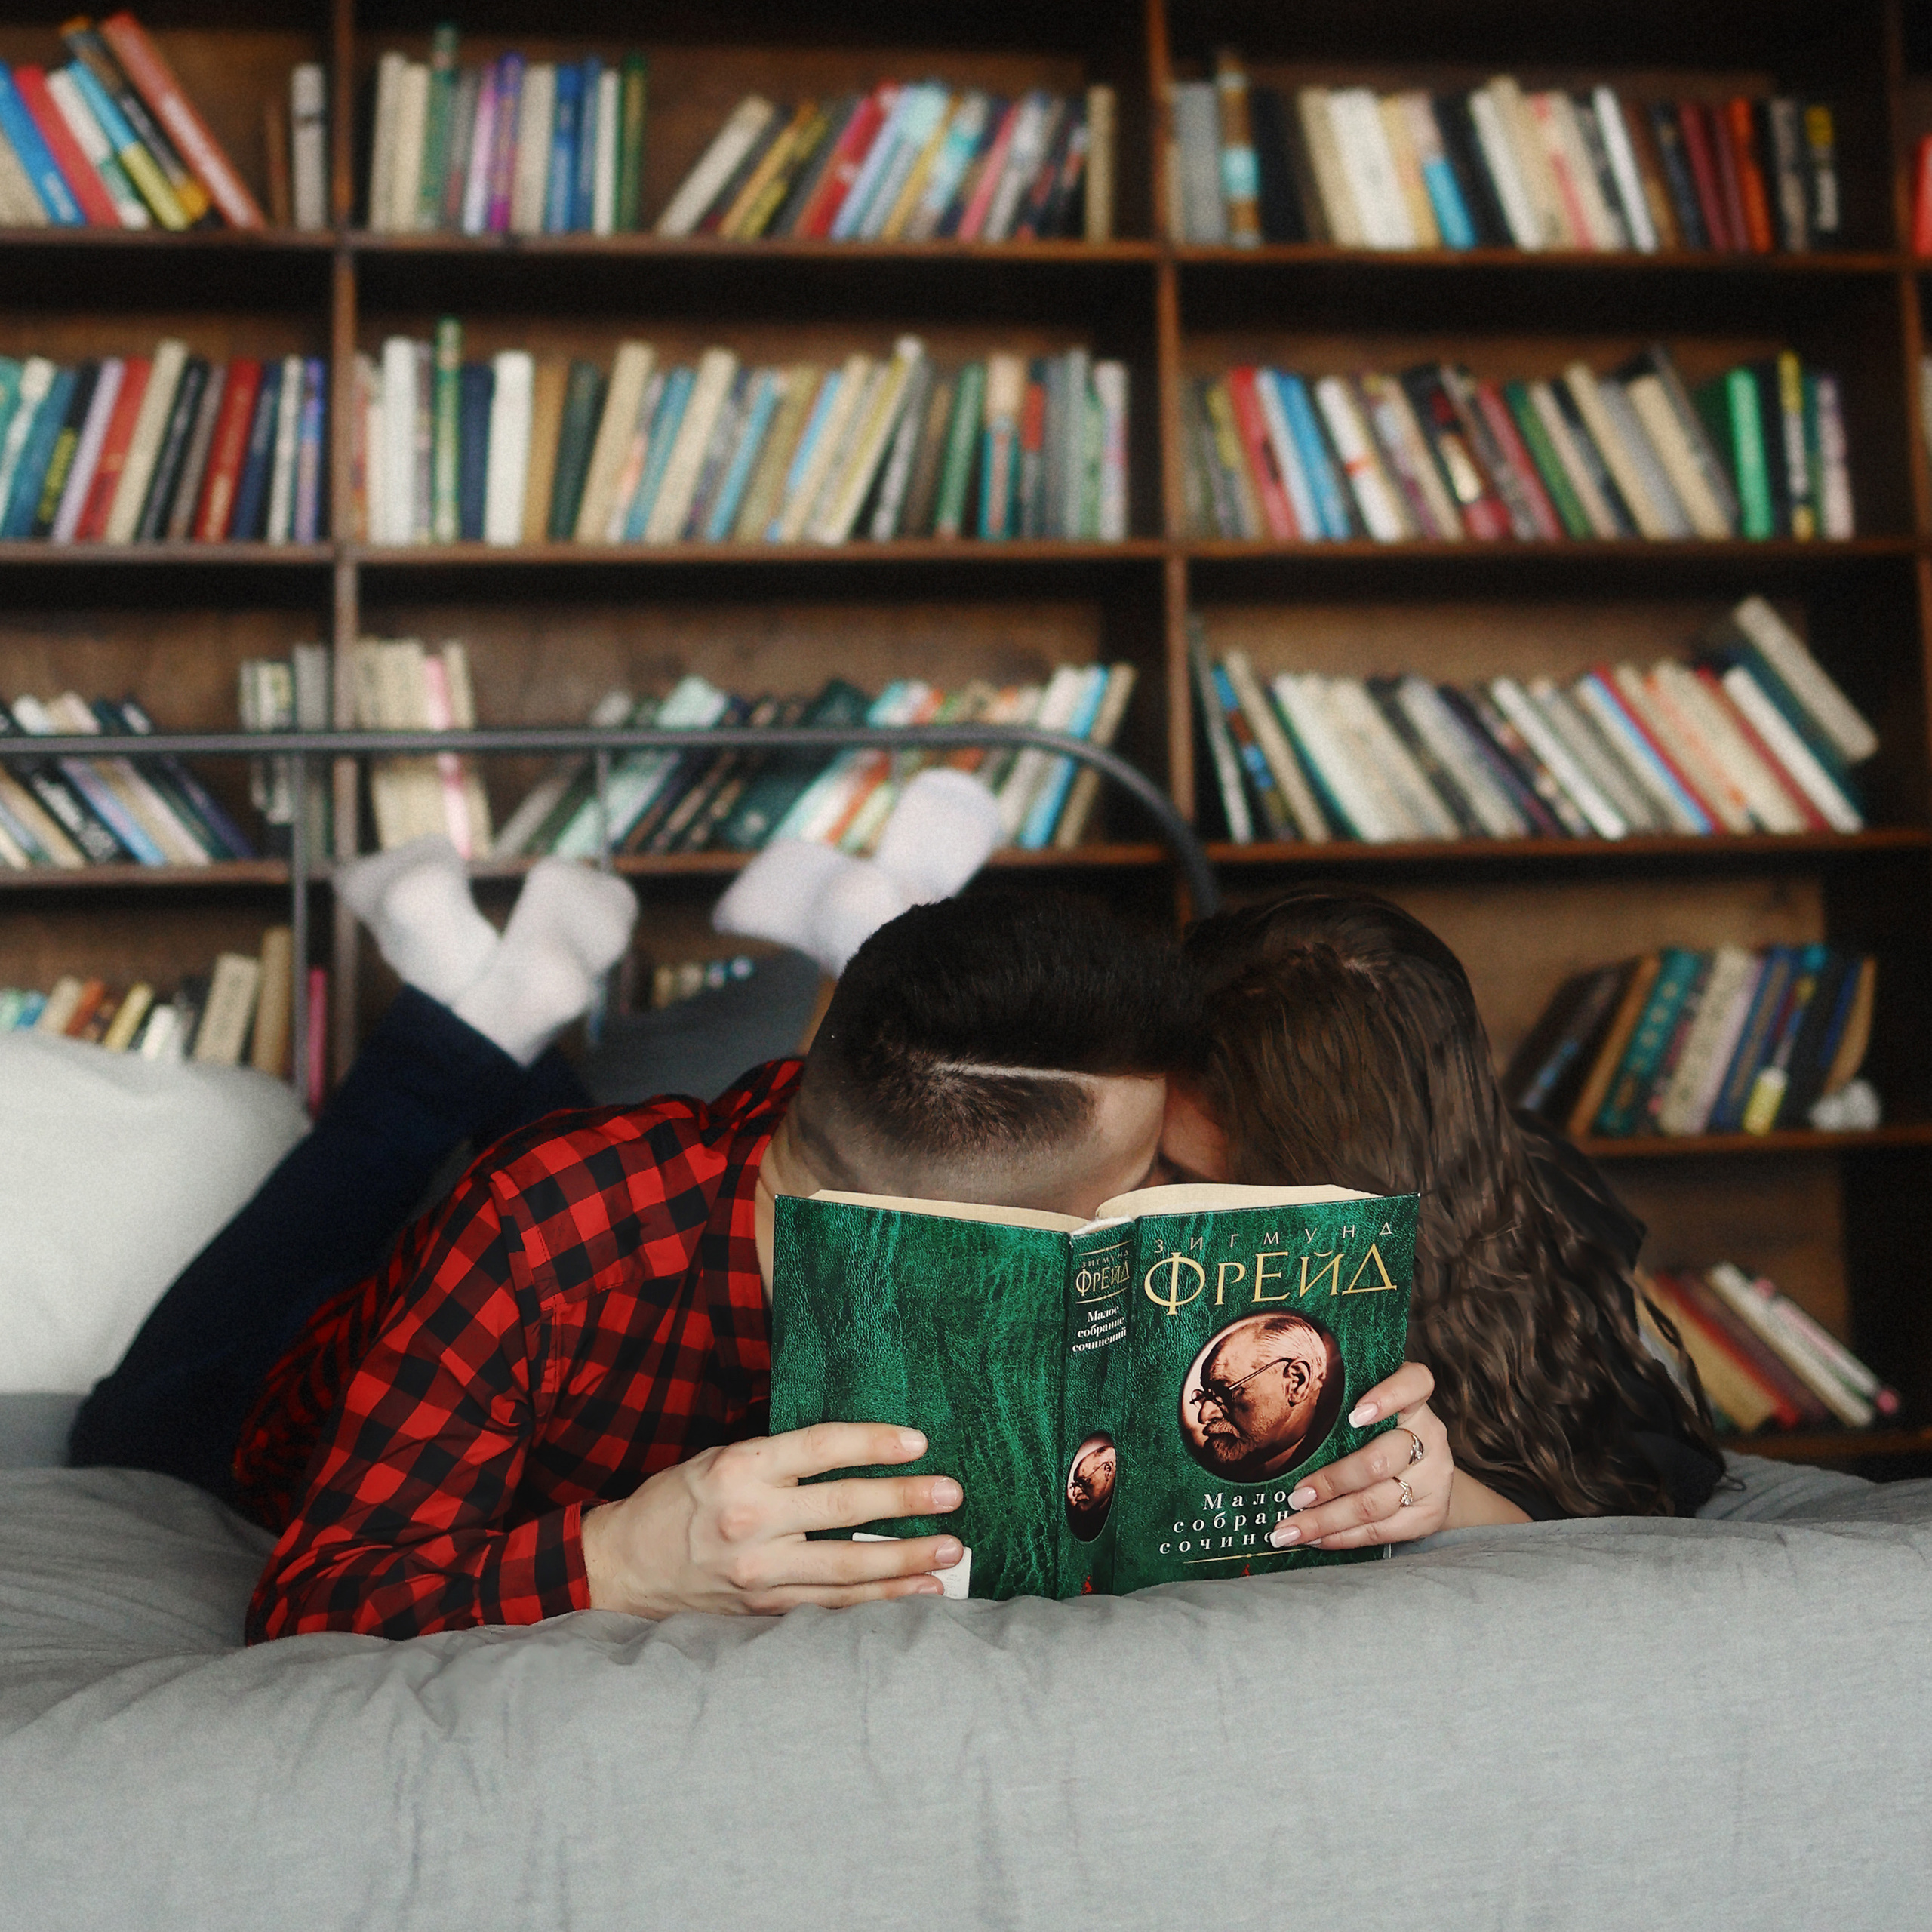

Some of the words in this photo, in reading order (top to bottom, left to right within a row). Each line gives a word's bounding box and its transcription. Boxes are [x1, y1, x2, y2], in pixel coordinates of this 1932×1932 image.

[1154, 1221, 1392, 1254] ЗИГМУНД
[1076, 1260, 1130, 1297] ФРЕЙД
[1144, 1242, 1398, 1315] ФРЕЙД
[1088, 1306, 1120, 1322] Малое
[1072, 1326, 1127, 1352] сочинений
[1077, 1317, 1124, 1338] собрание
[1202, 1491, 1286, 1510] Мало
[1173, 1511, 1303, 1533] собран
